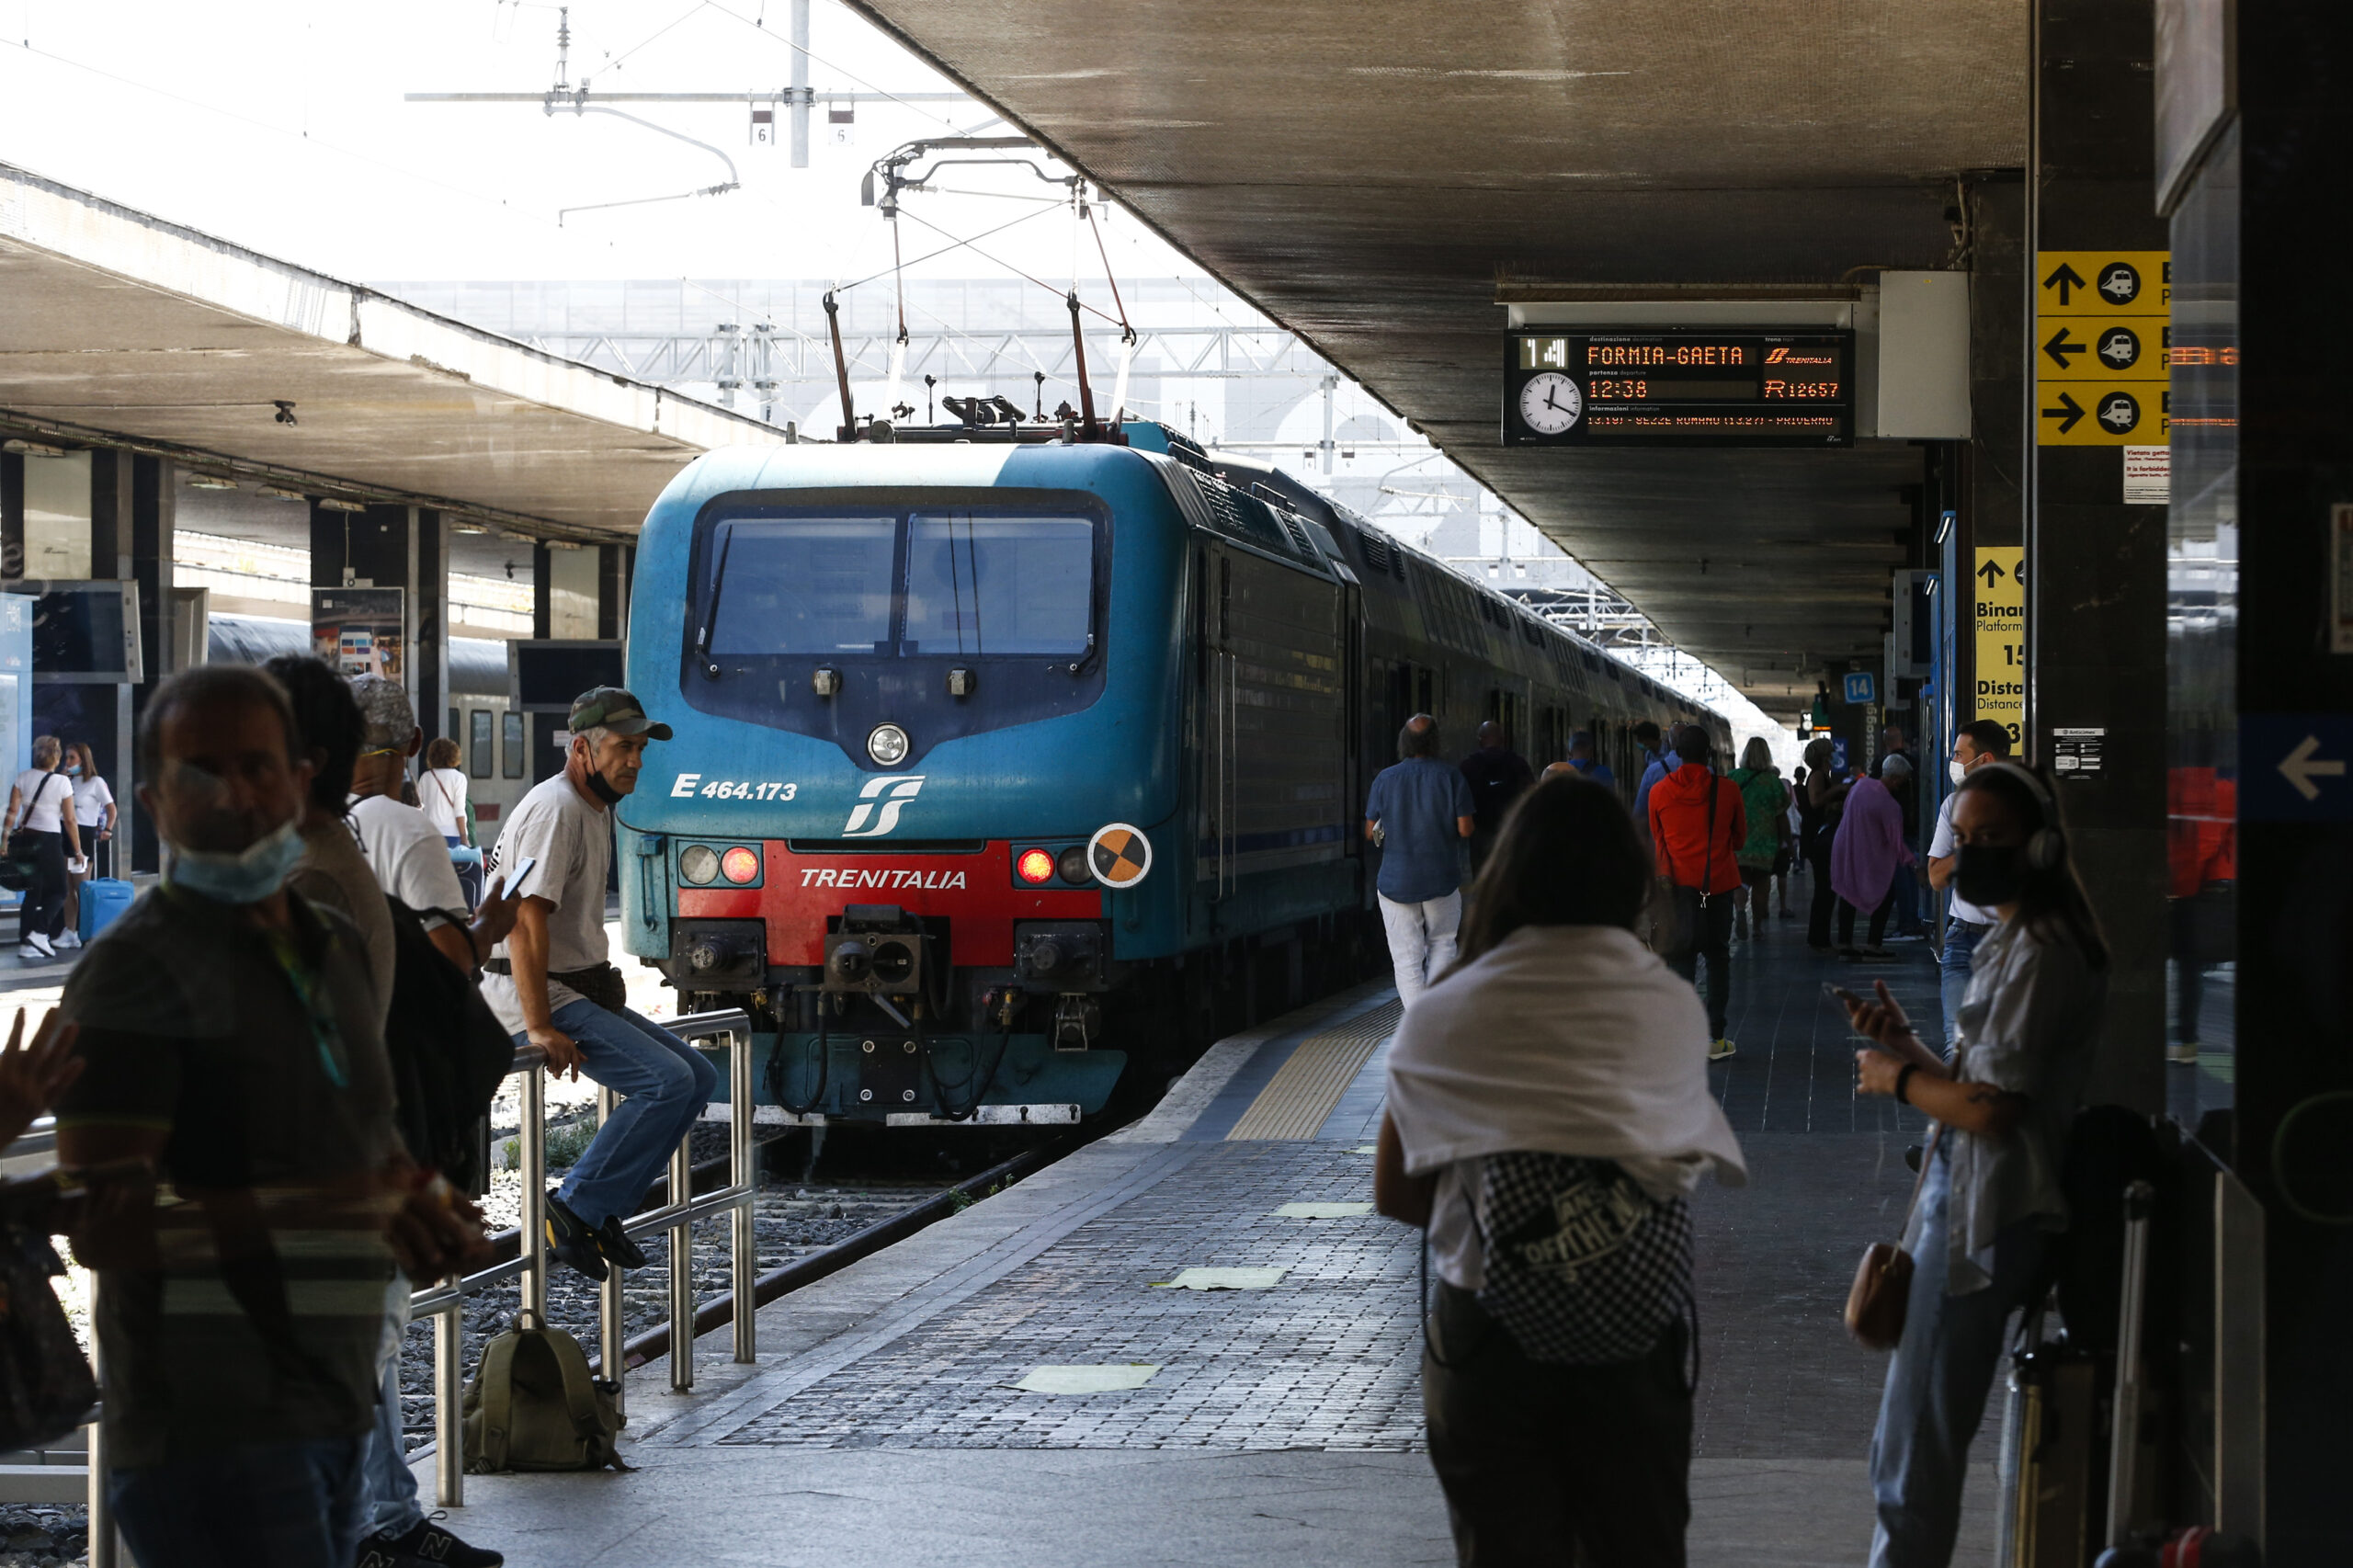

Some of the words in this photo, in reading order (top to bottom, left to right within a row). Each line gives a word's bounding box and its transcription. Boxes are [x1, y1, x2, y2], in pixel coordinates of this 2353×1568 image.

[758, 129, 766, 142] 6
[1588, 347, 1743, 365] FORMIA-GAETA
[1589, 380, 1647, 398] 12:38
[1850, 678, 1869, 697] 14
[670, 773, 701, 798] E
[701, 781, 797, 801] 464.173
[801, 869, 966, 890] TRENITALIA
[418, 1531, 452, 1561] N
